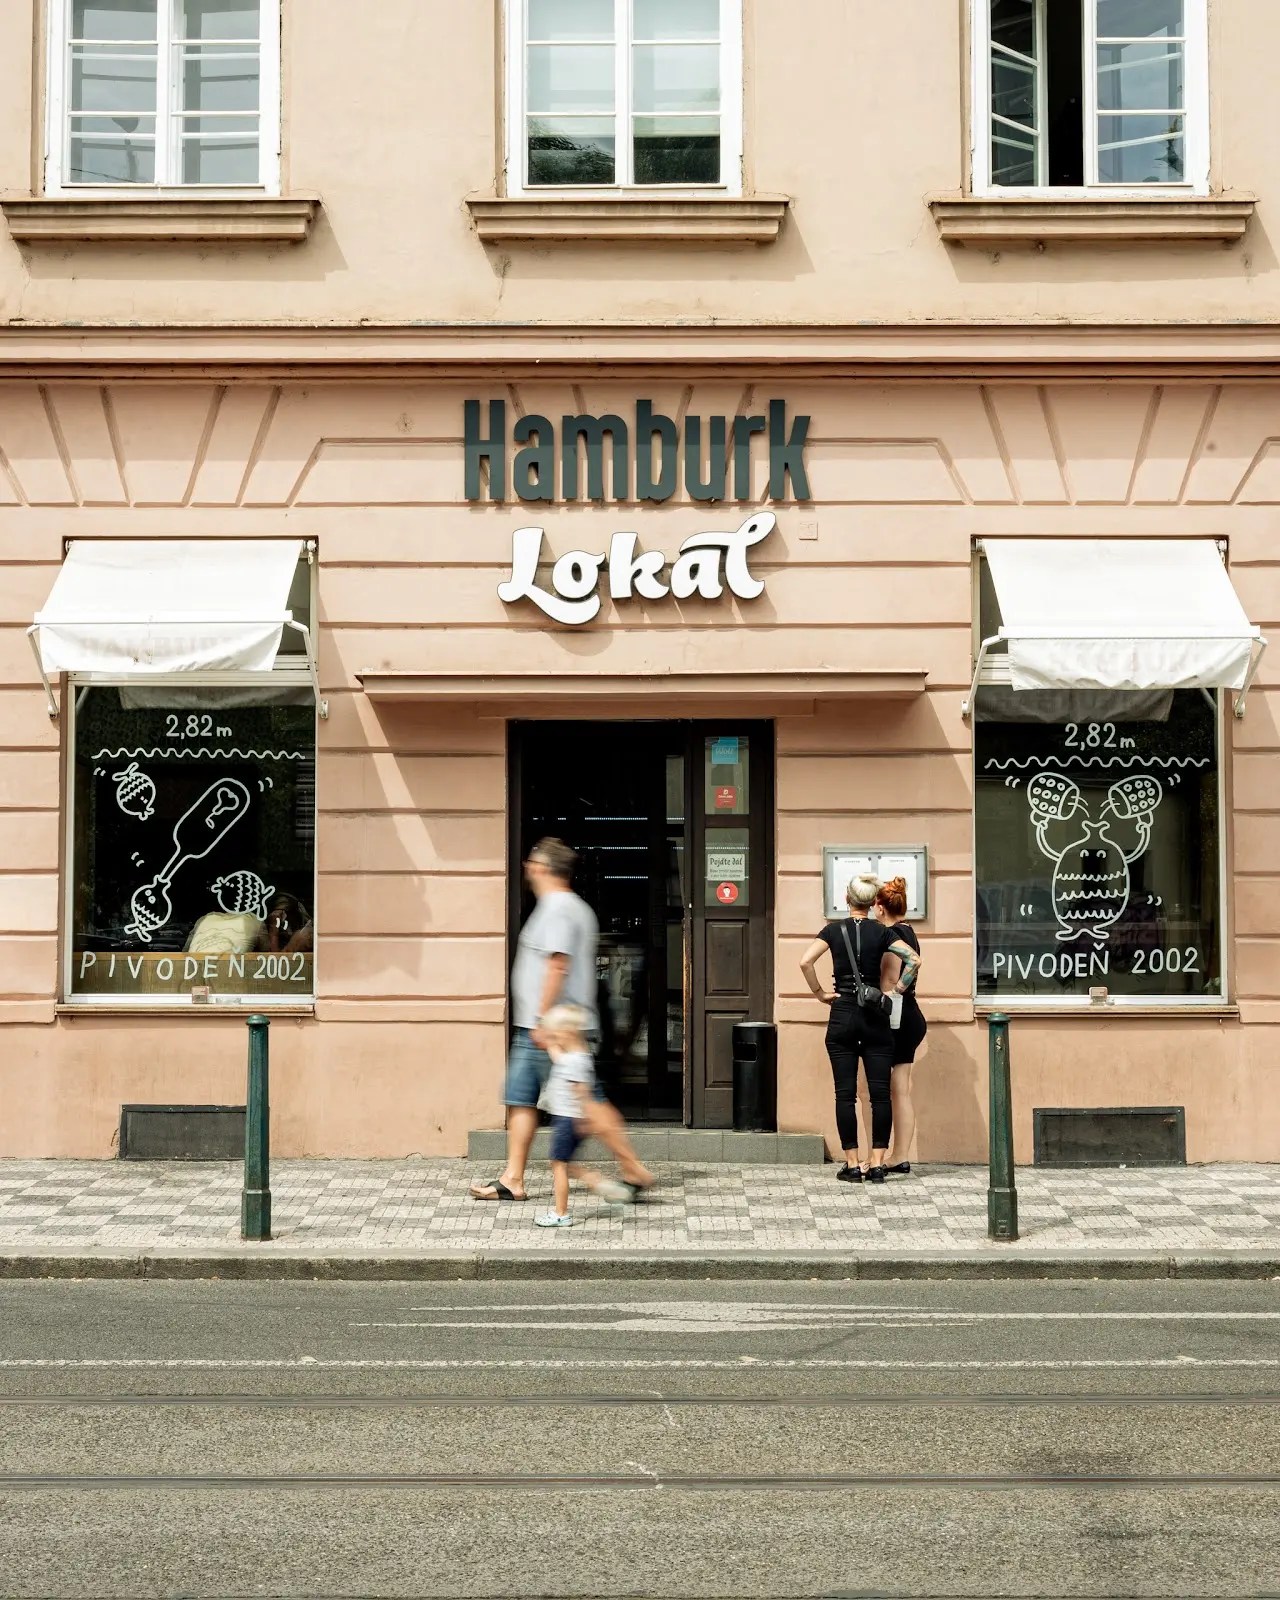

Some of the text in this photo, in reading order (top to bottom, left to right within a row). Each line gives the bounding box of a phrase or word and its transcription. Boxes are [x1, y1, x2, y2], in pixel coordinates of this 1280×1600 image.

[464, 399, 811, 500] Hamburk
[79, 947, 306, 981] PIVODEŇ 2002
[992, 942, 1200, 980] PIVODEŇ 2002
